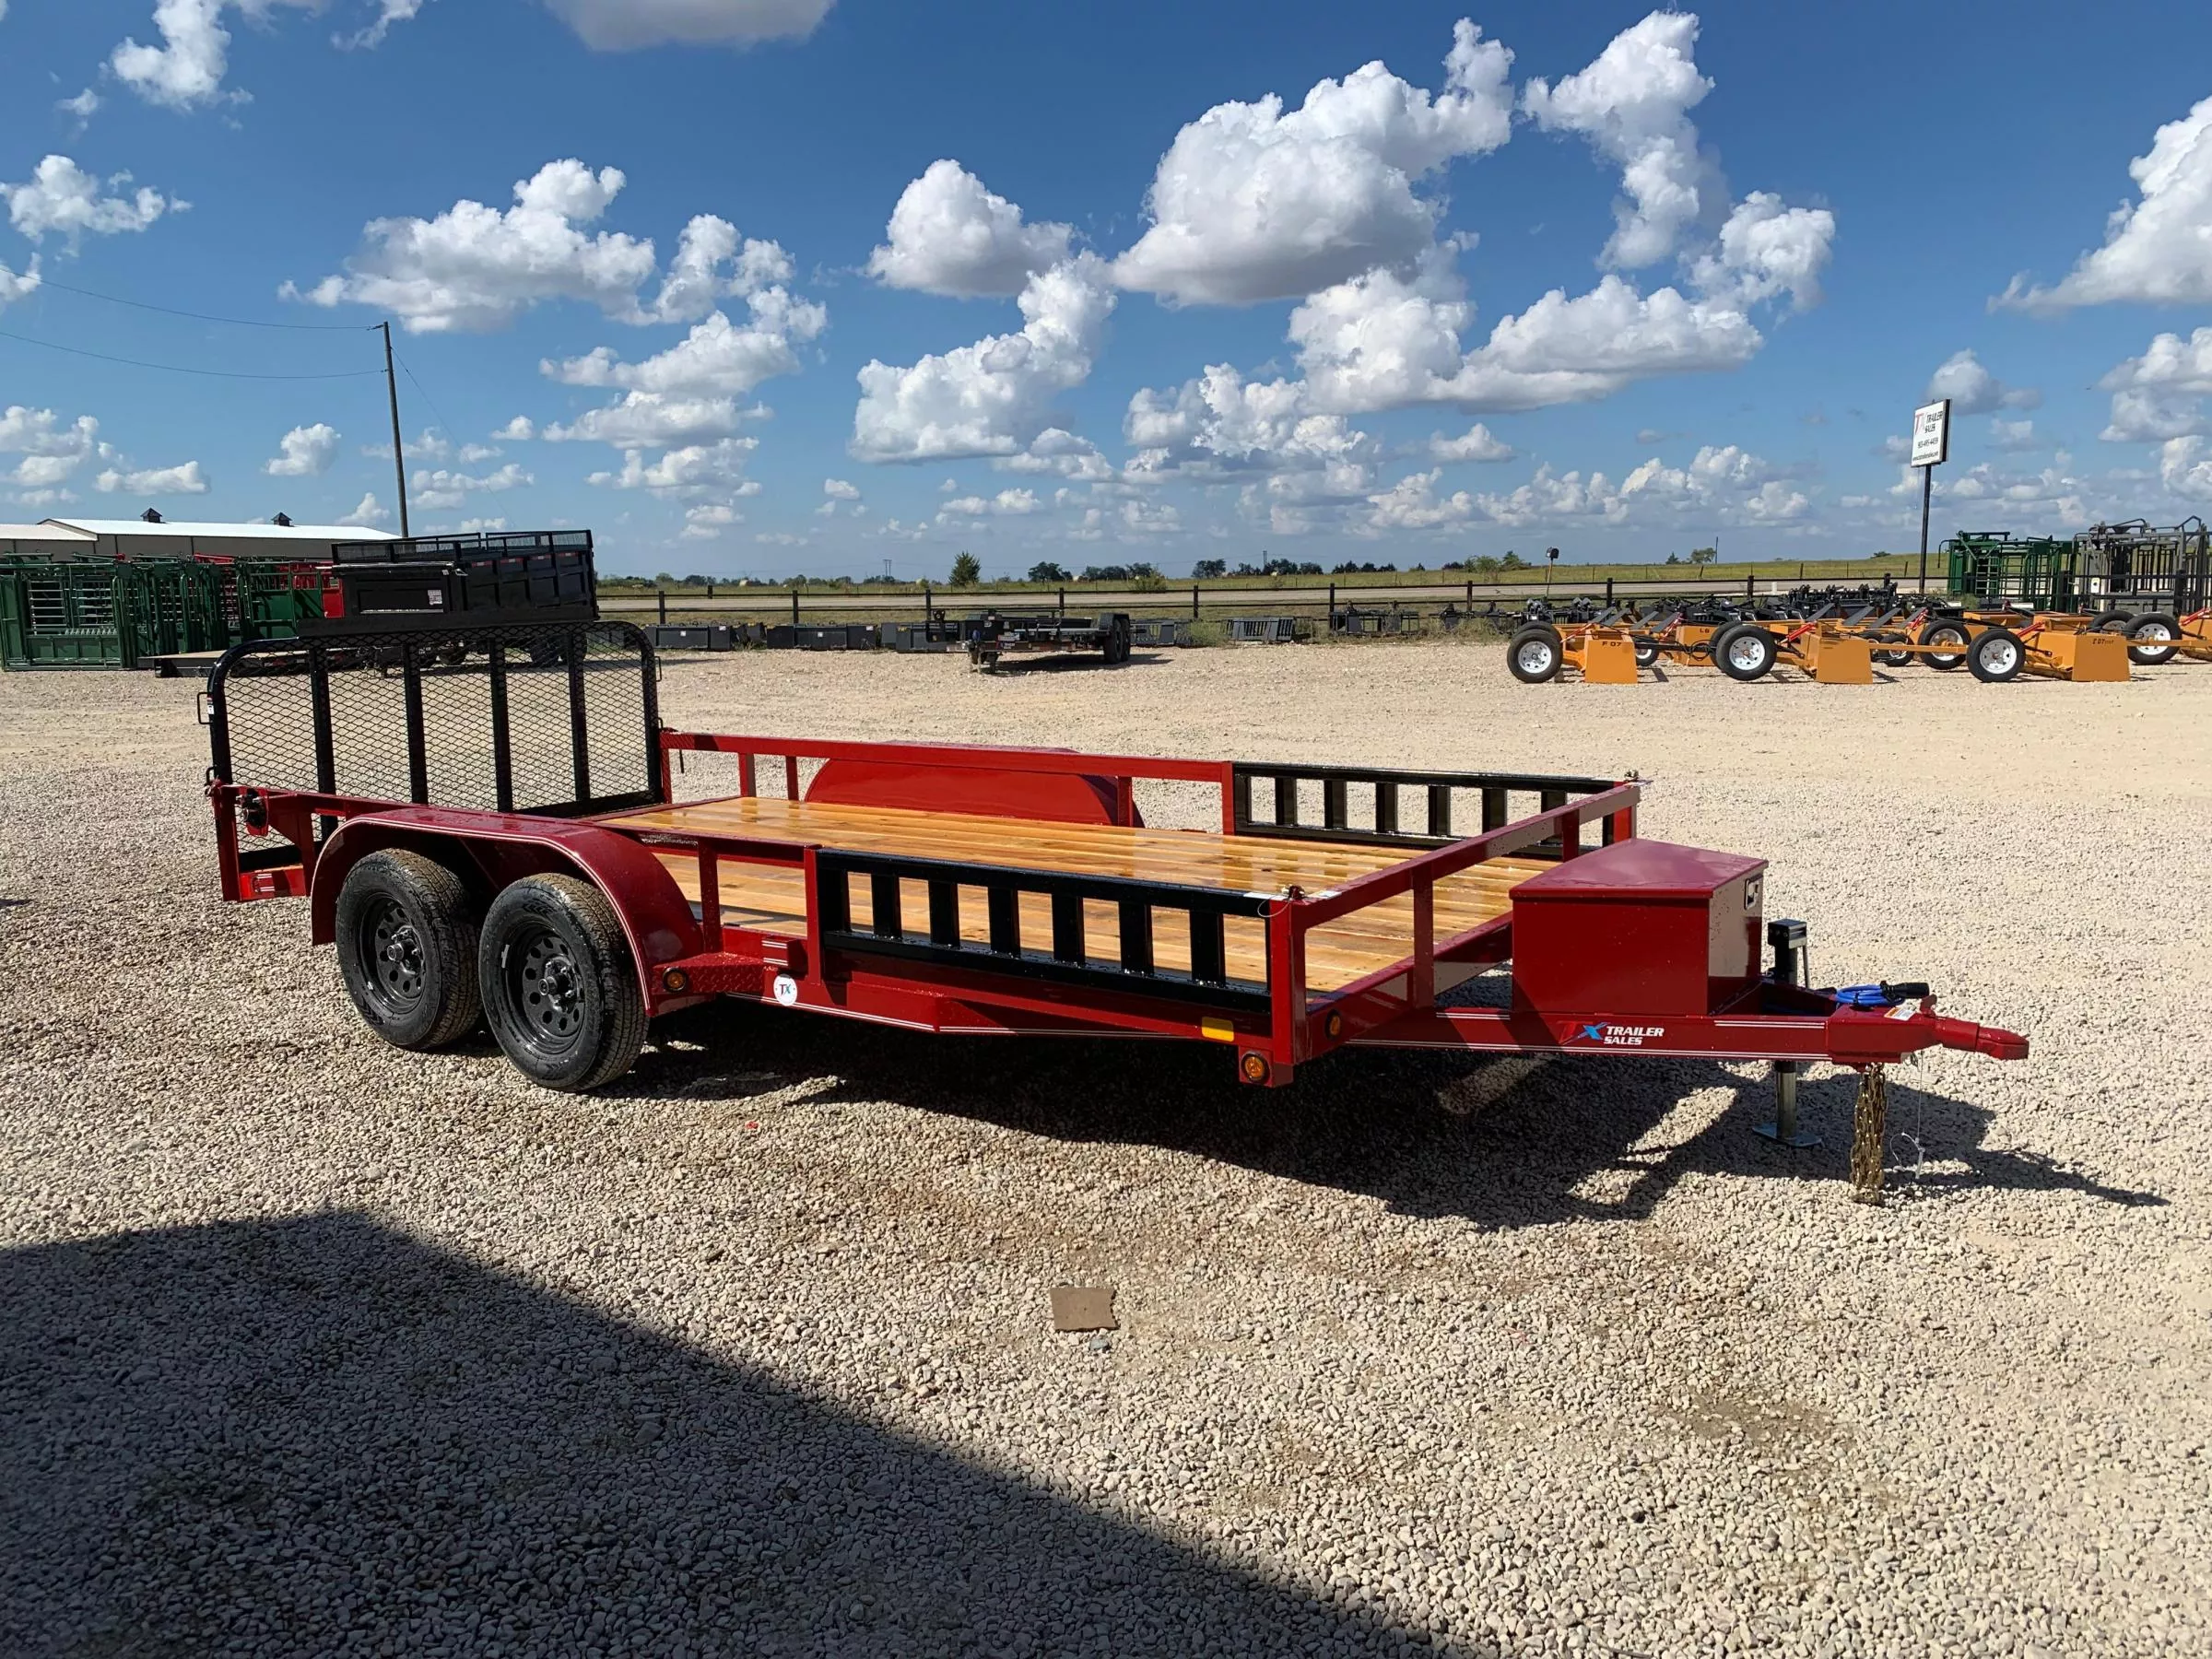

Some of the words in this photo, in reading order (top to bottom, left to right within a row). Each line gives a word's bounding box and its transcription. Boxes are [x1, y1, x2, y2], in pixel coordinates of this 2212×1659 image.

[778, 982, 793, 996] TX
[1605, 1026, 1665, 1037] TRAILER
[1604, 1036, 1643, 1045] SALES
